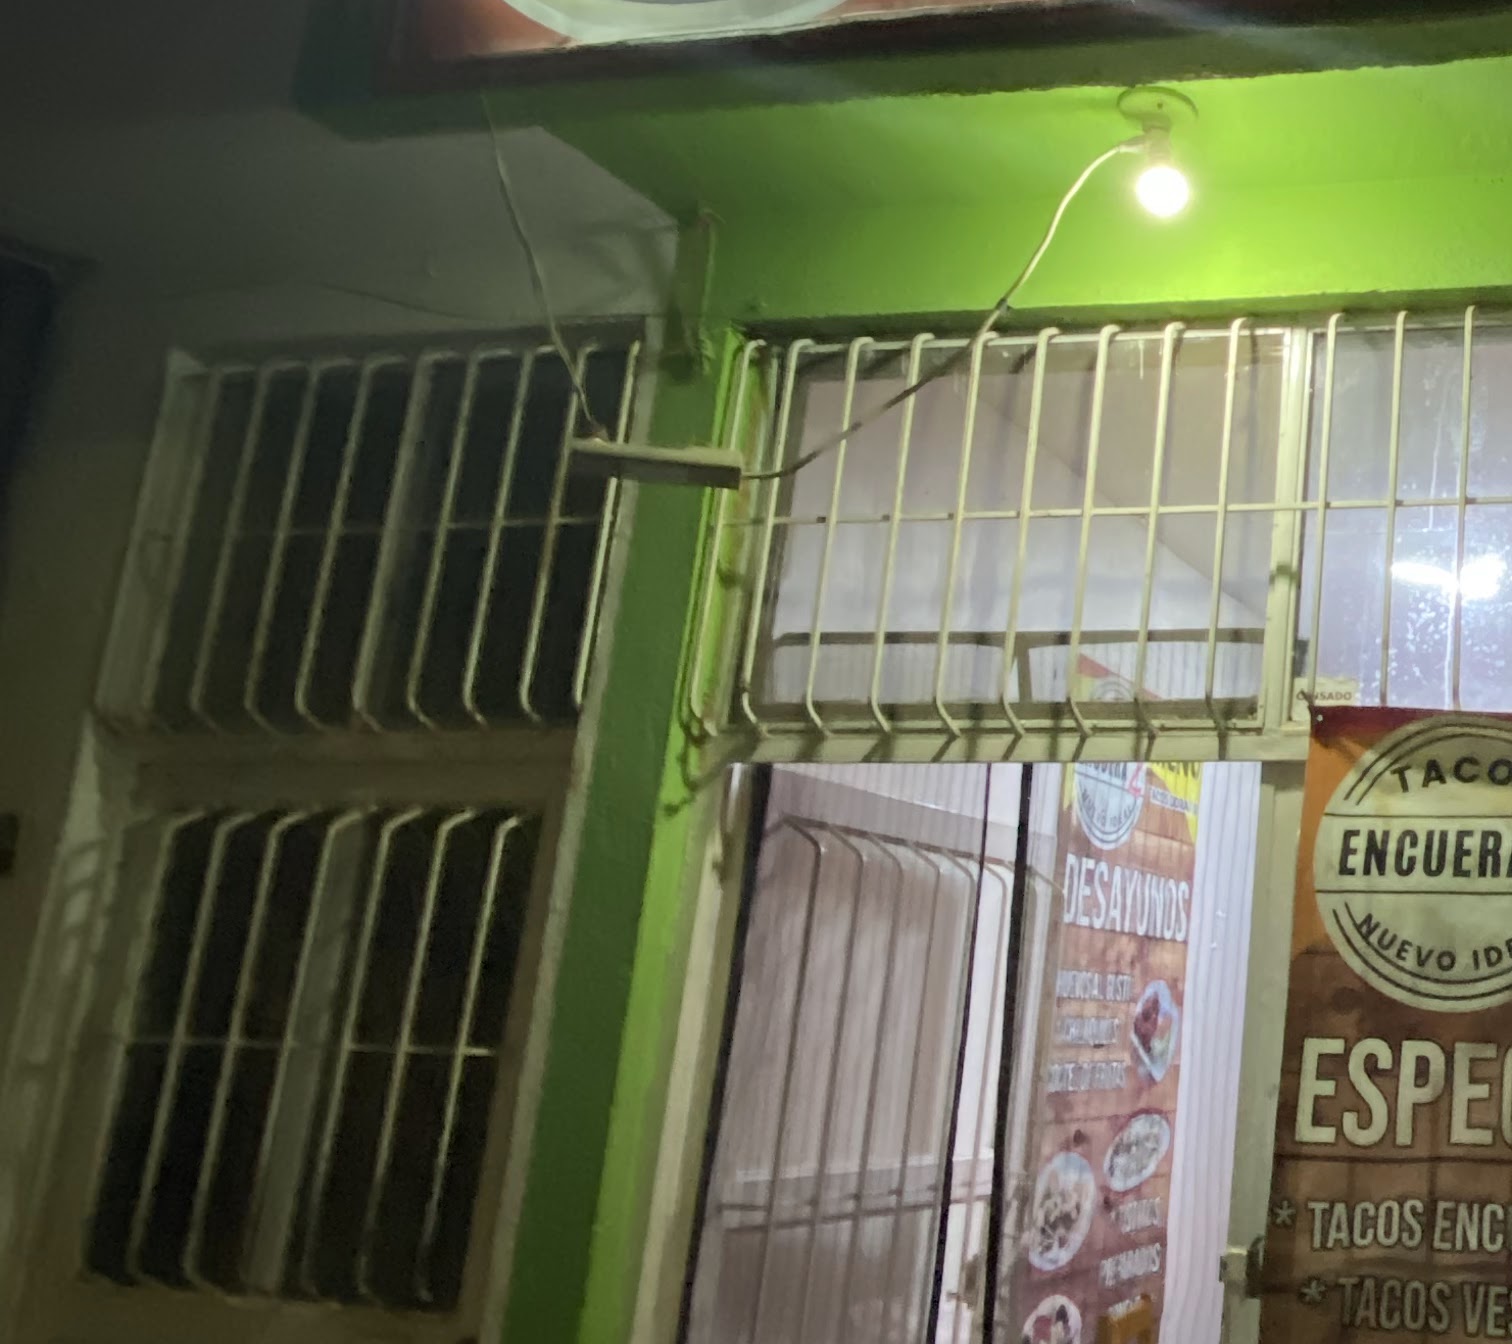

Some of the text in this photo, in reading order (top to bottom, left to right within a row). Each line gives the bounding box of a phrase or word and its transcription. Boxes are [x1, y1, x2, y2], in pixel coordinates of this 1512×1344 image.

[1062, 853, 1189, 941] DESAYUNOS
[1356, 913, 1456, 972] NUEVO
[1307, 1199, 1422, 1249] TACOS
[1337, 1277, 1452, 1334] TACOS
